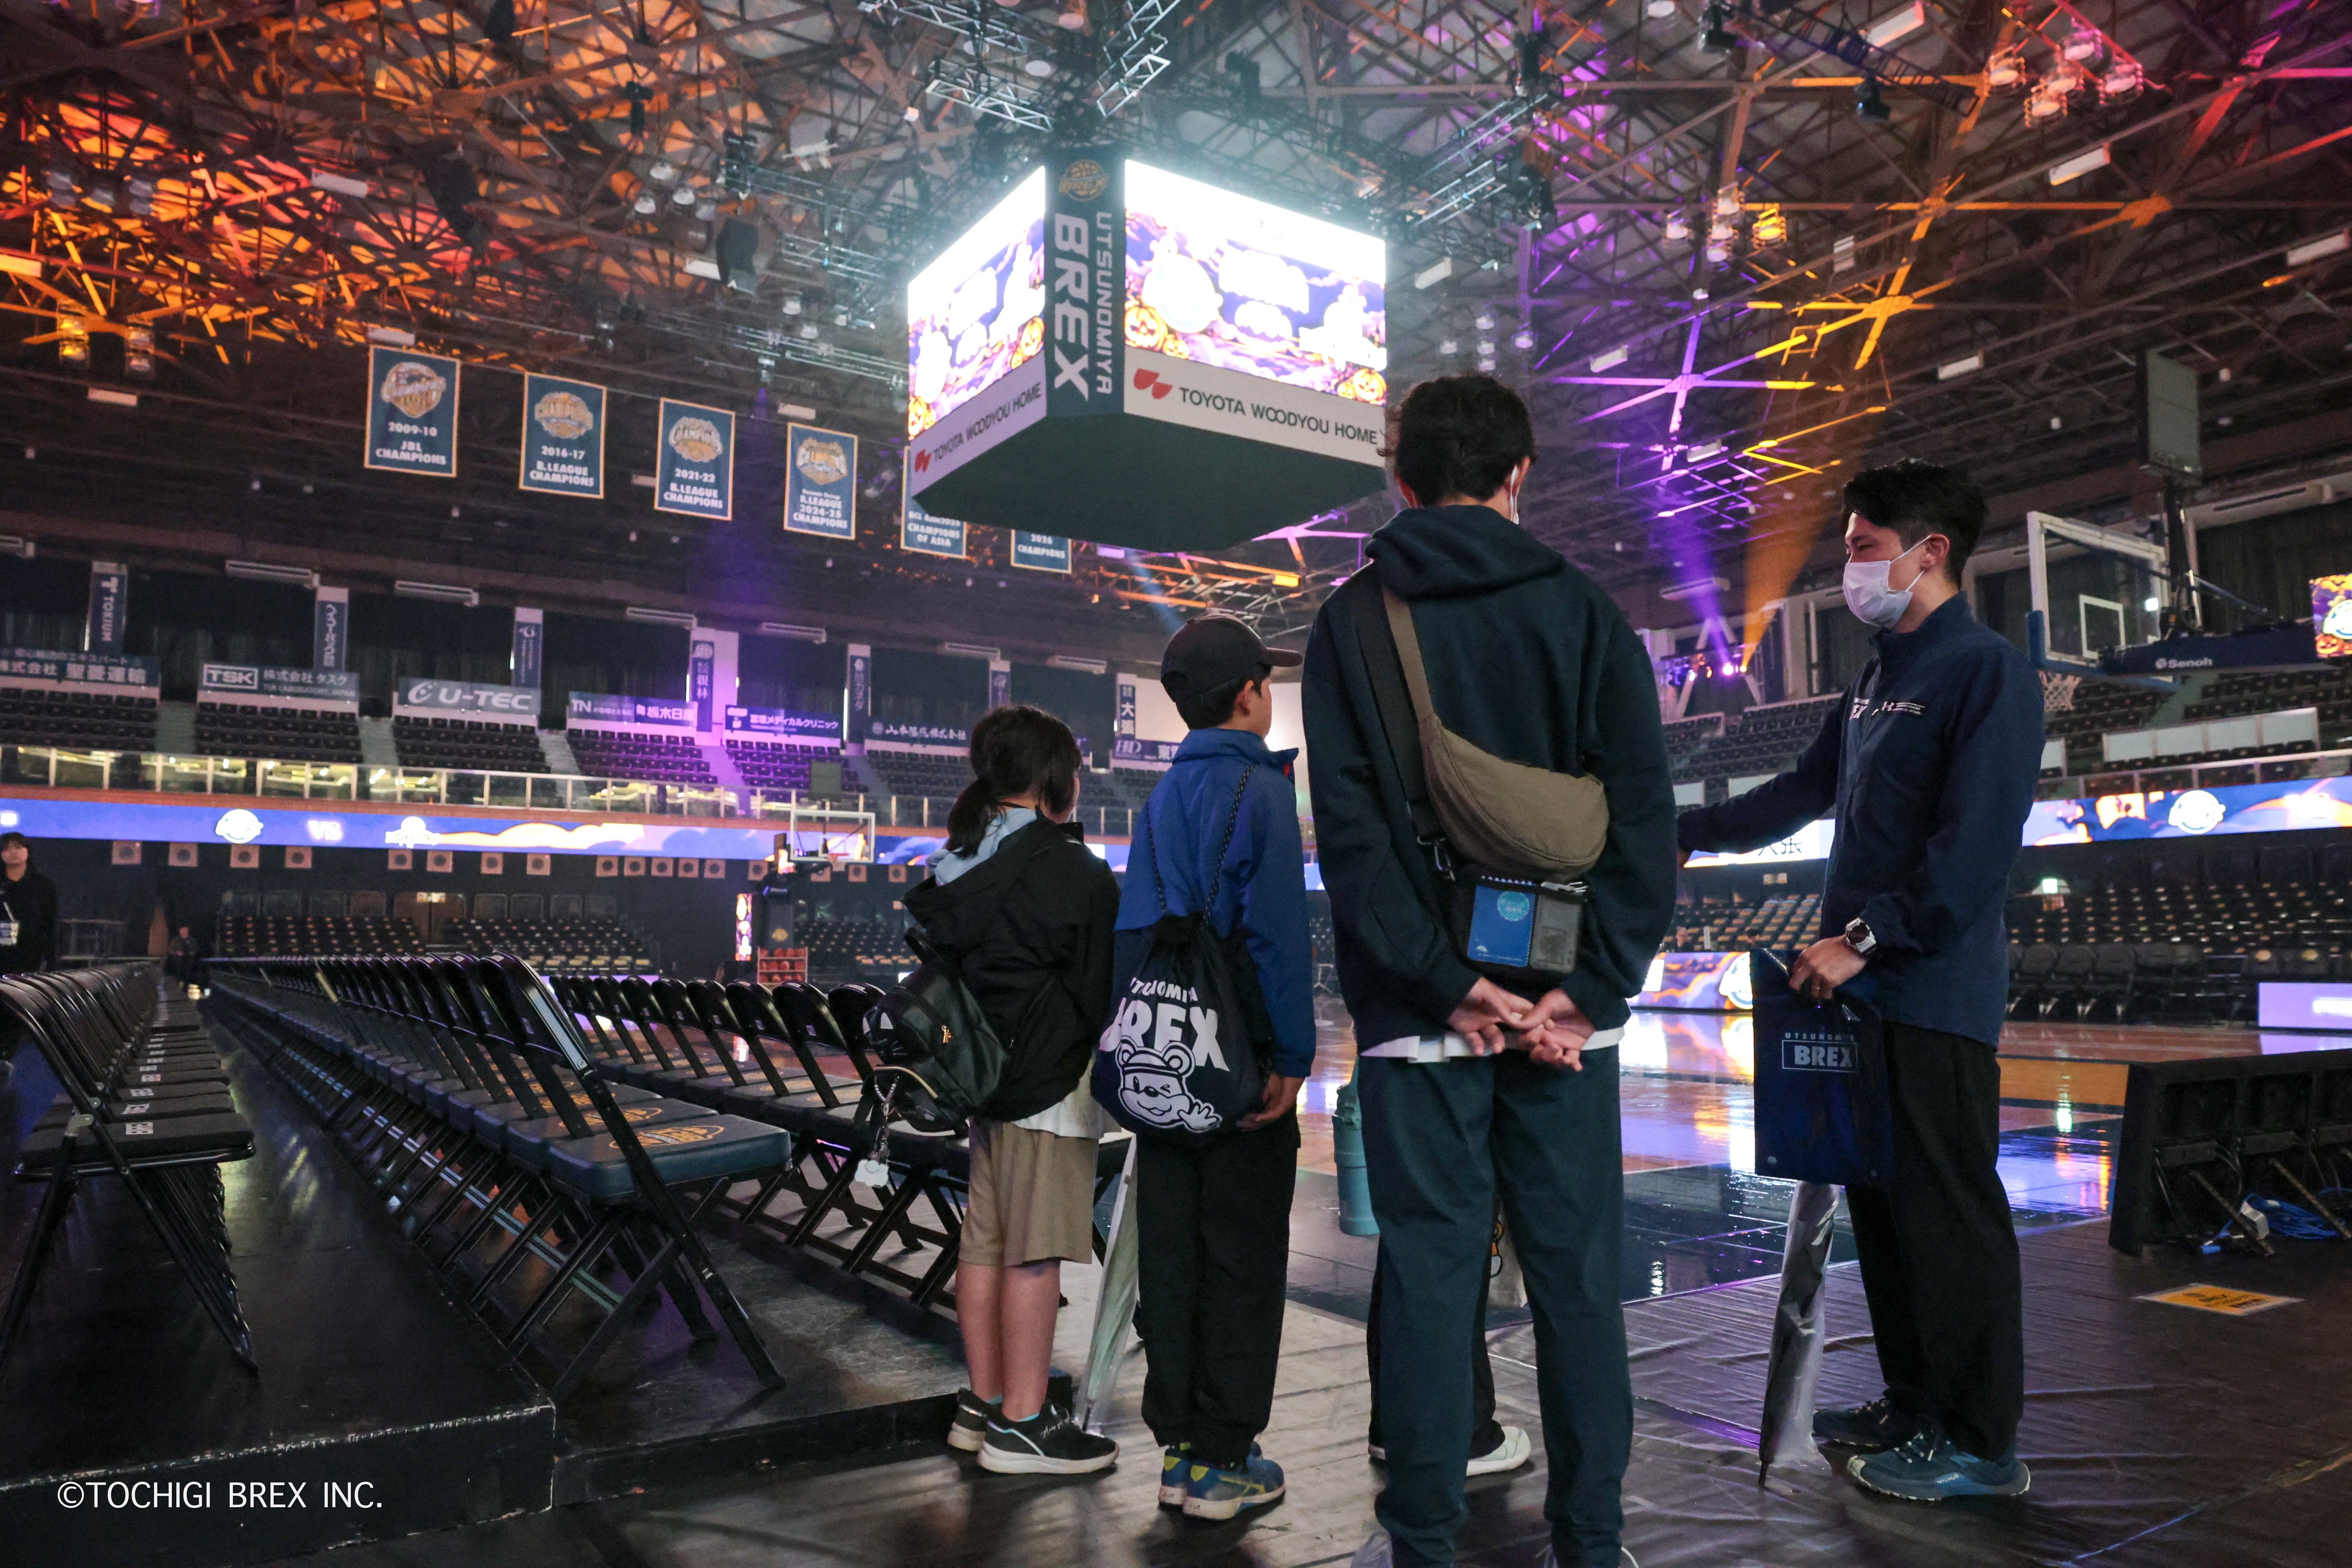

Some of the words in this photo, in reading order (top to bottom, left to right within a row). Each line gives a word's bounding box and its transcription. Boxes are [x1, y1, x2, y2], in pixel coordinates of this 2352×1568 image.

[1054, 213, 1089, 401] BREX
[1096, 212, 1112, 394] UTSUNOMIYA
[935, 433, 963, 461] TOYOTA
[966, 402, 1010, 440] WOODYOU
[1013, 382, 1041, 410] HOME
[1180, 387, 1245, 416] TOYOTA
[1252, 403, 1328, 433] WOODYOU
[1335, 423, 1377, 444] HOME
[388, 421, 437, 437] 2009-10
[401, 441, 421, 452] JBL
[541, 446, 585, 460] 2016-17
[376, 448, 446, 466] CHAMPIONS
[537, 461, 588, 477] B.LEAGUE
[675, 468, 716, 483] 2021-22
[529, 470, 594, 487] CHAMPIONS
[670, 483, 718, 499] B.LEAGUE
[663, 491, 723, 509] CHAMPIONS
[800, 495, 842, 509] B.LEAGUE
[800, 504, 842, 518] 2024-25
[793, 512, 848, 529] CHAMPIONS
[907, 523, 960, 539] CHAMPIONS
[917, 534, 928, 543] OF
[930, 536, 951, 546] ASIA
[1017, 544, 1065, 559] CHAMPIONS
[2169, 657, 2212, 668] Senoh
[207, 669, 254, 685] TSK
[263, 669, 312, 684] 株式会社
[316, 674, 347, 686] タスク
[439, 688, 532, 710] U-TEC
[308, 820, 341, 840] VS
[1794, 1045, 1853, 1067] BREX
